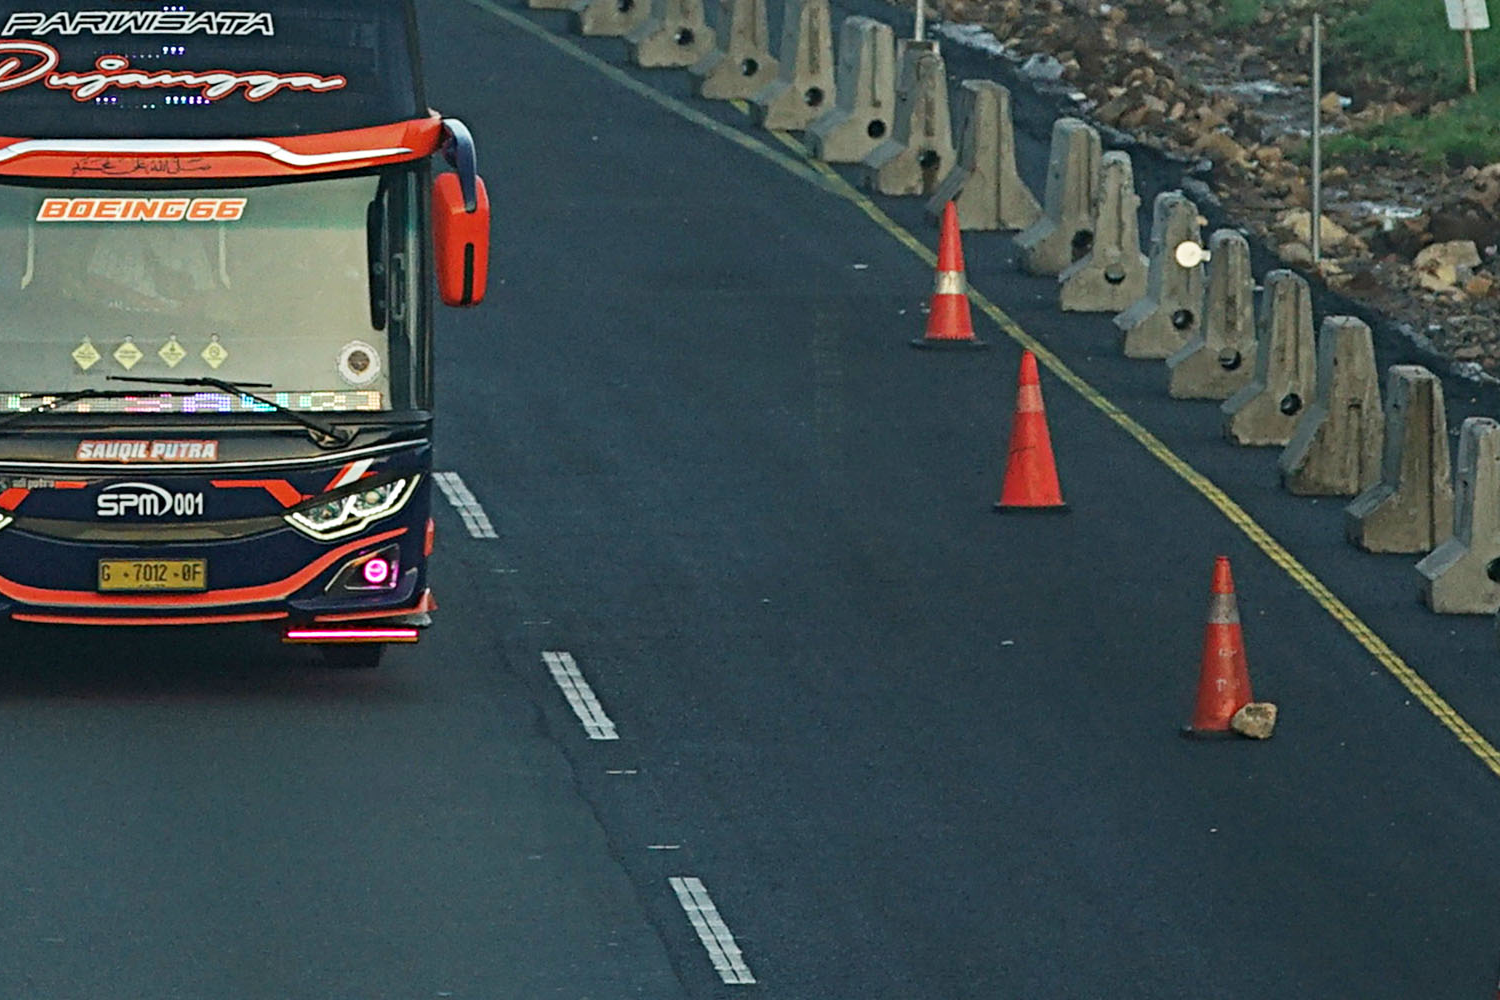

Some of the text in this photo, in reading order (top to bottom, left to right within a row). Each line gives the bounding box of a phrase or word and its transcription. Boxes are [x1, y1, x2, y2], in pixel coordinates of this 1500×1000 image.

[1, 11, 273, 36] PARIWISATA
[79, 441, 216, 460] SAUQIL PUTRA
[97, 488, 203, 516] SPM 001
[101, 564, 111, 581] G
[133, 564, 168, 581] 7012
